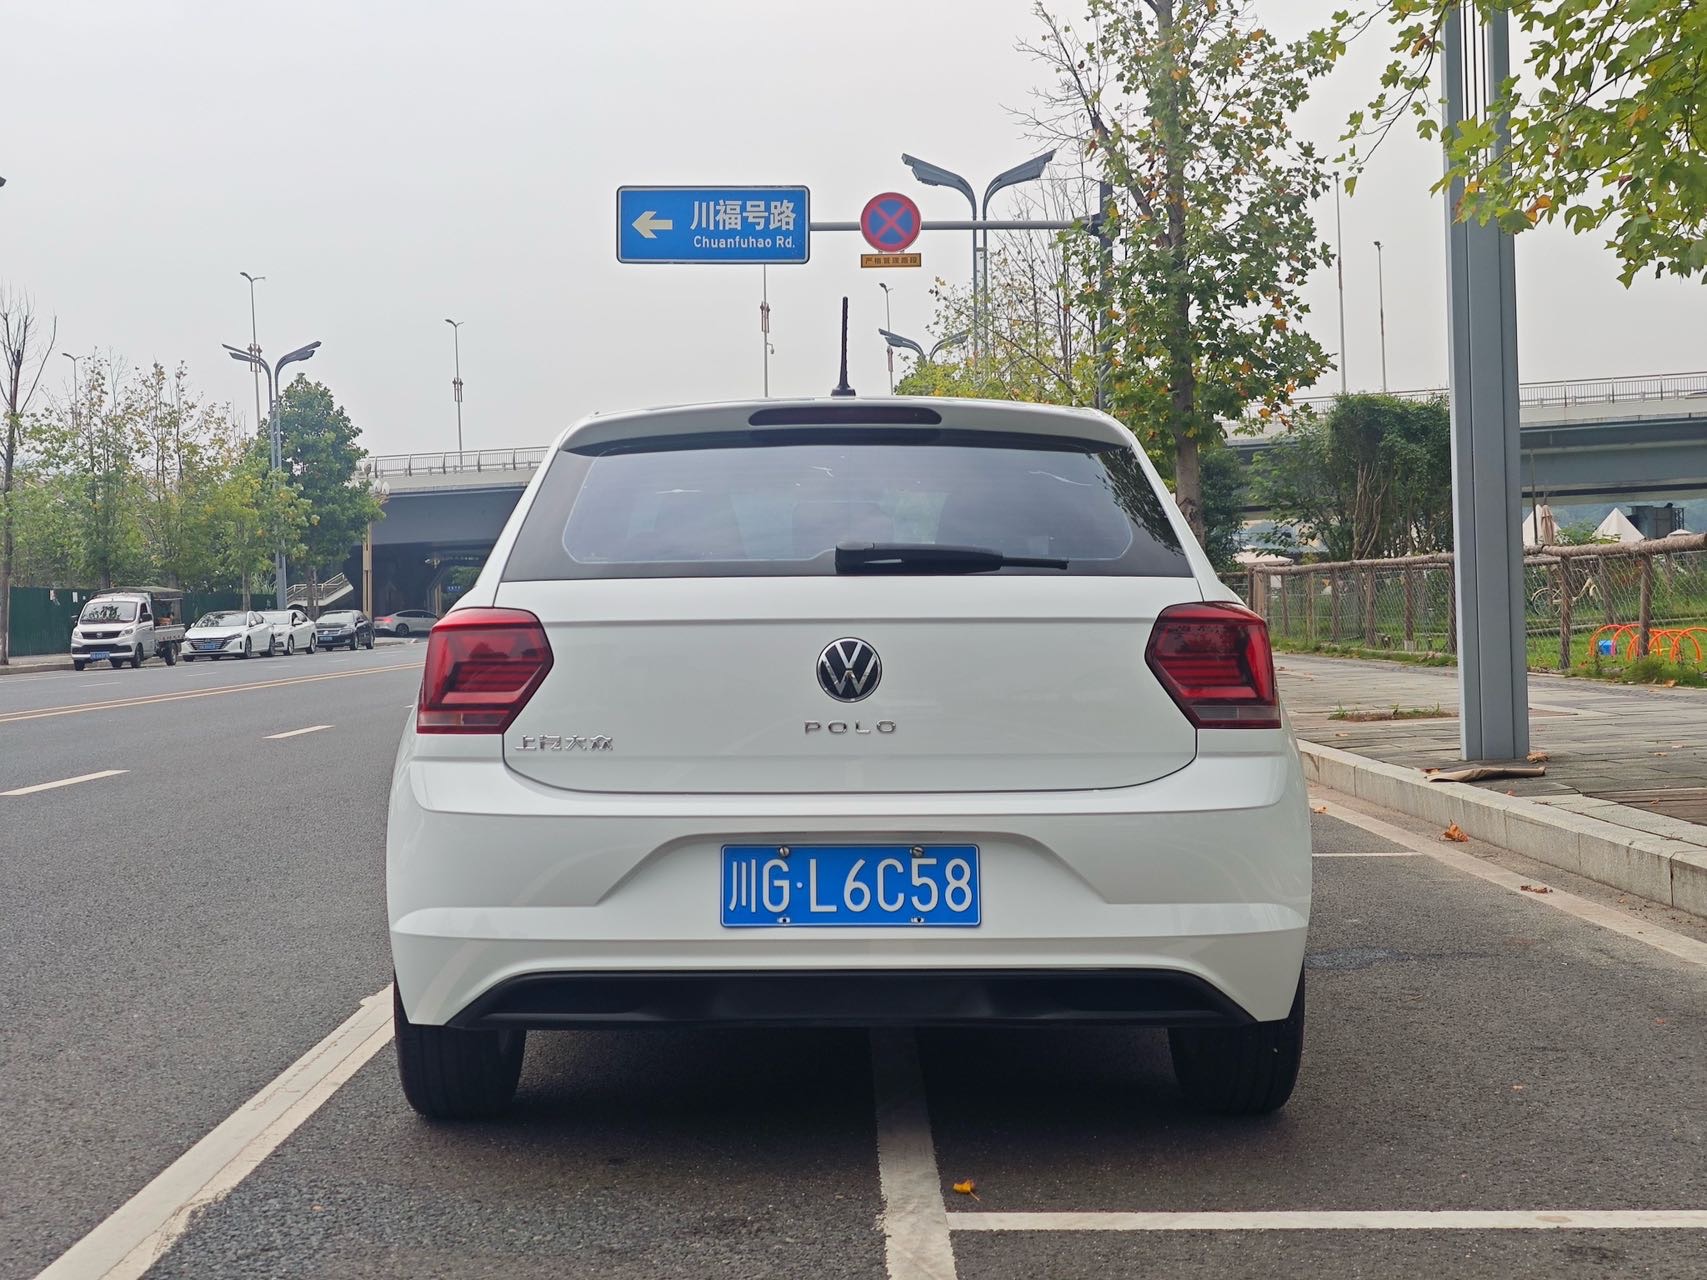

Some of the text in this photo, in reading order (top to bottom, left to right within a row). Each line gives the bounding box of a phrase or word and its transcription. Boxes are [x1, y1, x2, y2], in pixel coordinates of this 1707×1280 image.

[690, 200, 796, 230] 川福号路
[693, 236, 795, 248] Chuanfuhao Rd.
[805, 720, 896, 734] POLO
[515, 735, 613, 750] 上汽大众
